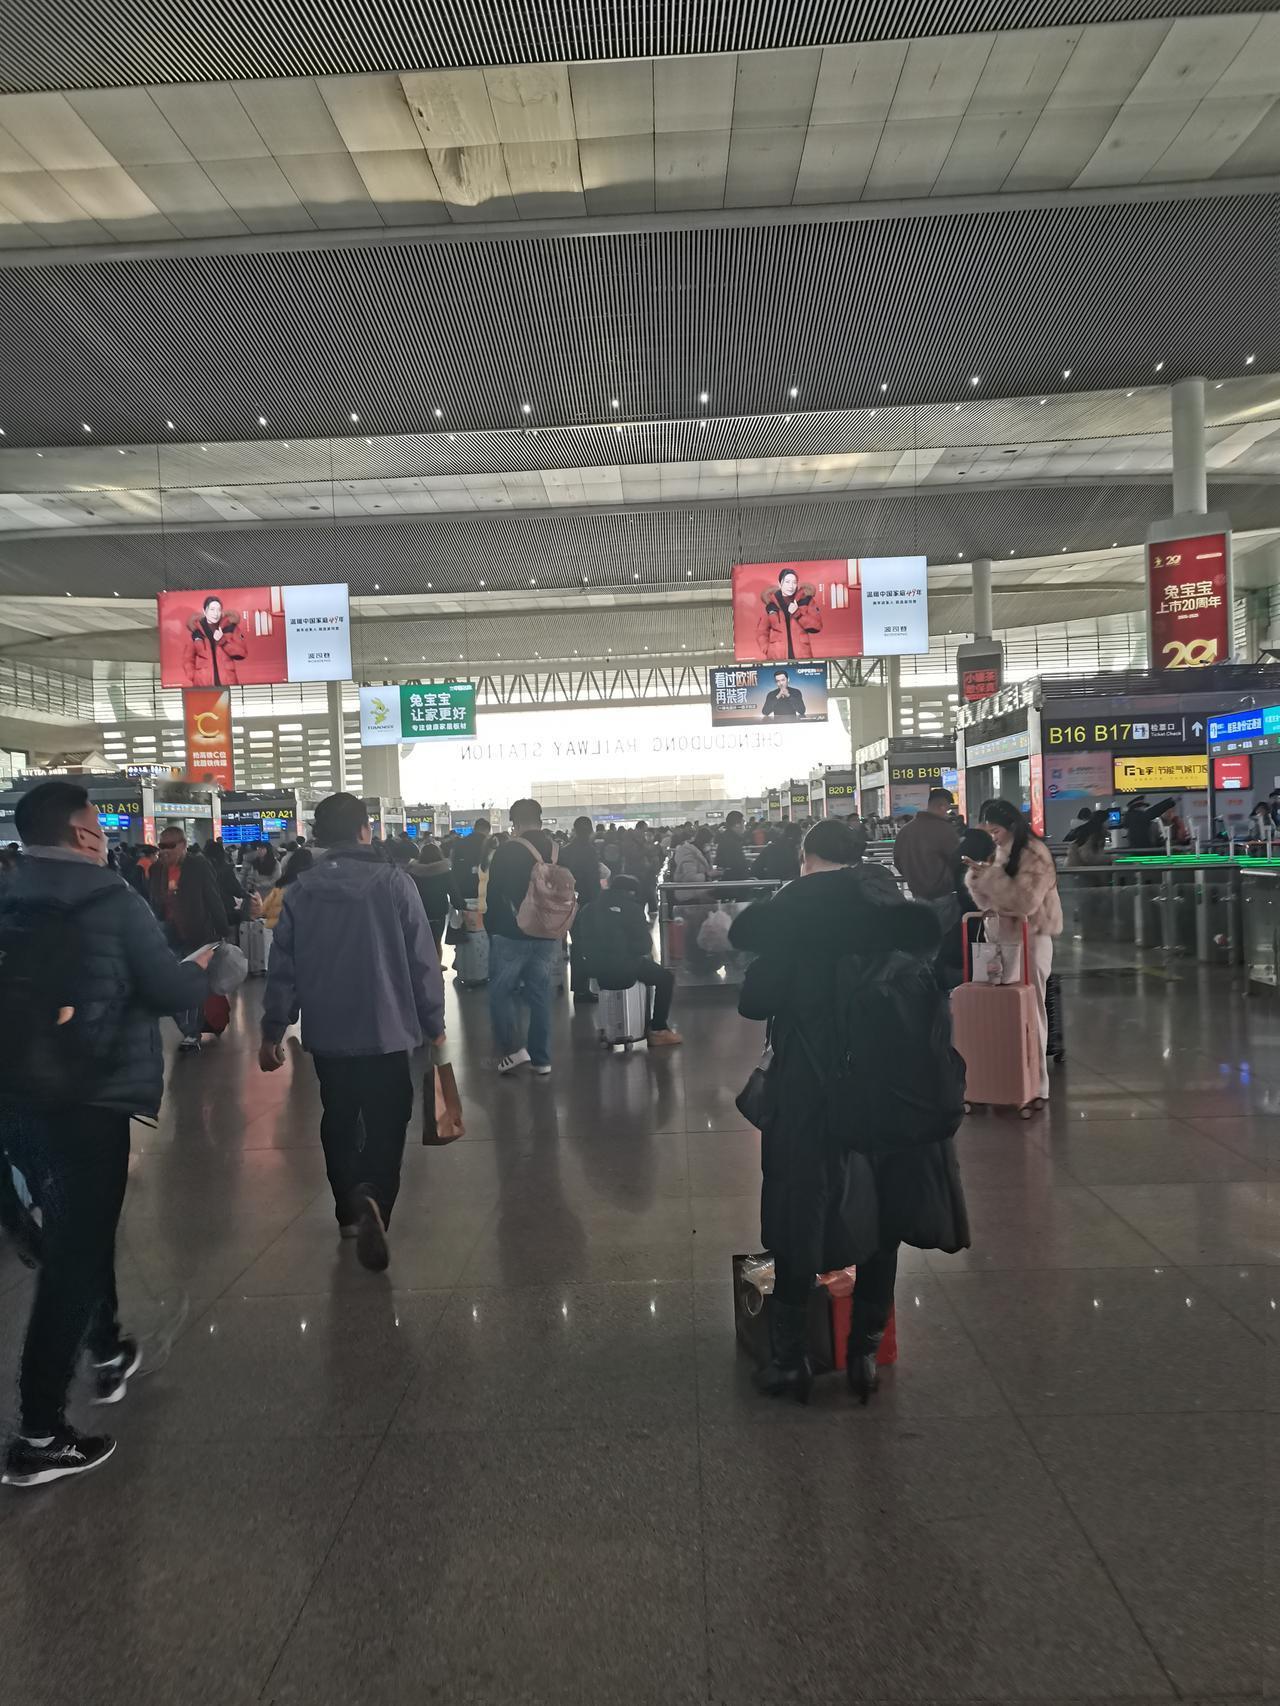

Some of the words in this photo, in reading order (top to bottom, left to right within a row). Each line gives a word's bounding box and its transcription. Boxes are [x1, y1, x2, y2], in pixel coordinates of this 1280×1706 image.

[1164, 580, 1213, 600] 兔宝宝
[1156, 596, 1222, 614] 上市20周年
[714, 671, 758, 688] 看过欧派
[410, 693, 451, 708] 兔宝宝
[715, 688, 748, 704] 再装家
[410, 707, 467, 722] 让家更好
[1050, 726, 1086, 744] B16
[1095, 723, 1132, 742] B17
[1151, 723, 1175, 731] 检票口
[892, 770, 914, 780] B18
[918, 767, 941, 778] B19
[828, 786, 844, 795] B20
[117, 803, 140, 814] A19
[261, 811, 276, 819] A20
[278, 810, 293, 818] A21
